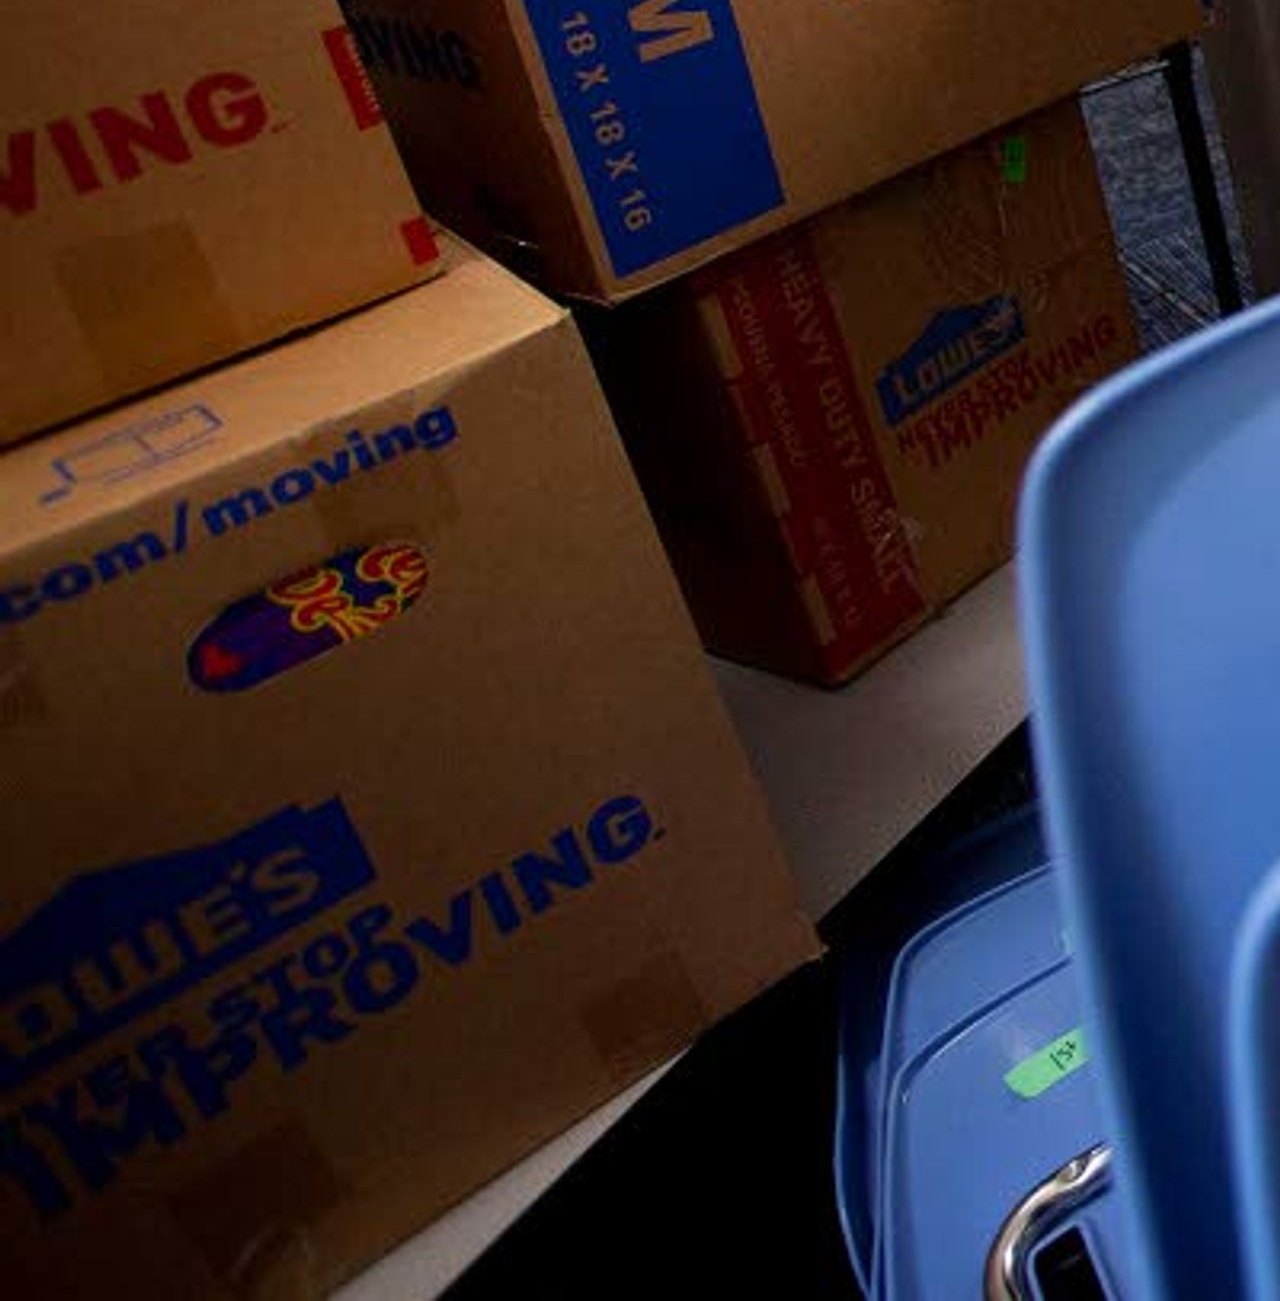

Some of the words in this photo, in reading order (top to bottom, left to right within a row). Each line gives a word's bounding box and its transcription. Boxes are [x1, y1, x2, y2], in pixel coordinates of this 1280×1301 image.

[560, 11, 596, 57] 18
[577, 66, 609, 92] X
[591, 102, 625, 148] 18
[606, 154, 637, 180] X
[621, 189, 652, 233] 16
[208, 905, 394, 1029] STOP
[1049, 1039, 1077, 1071] 1st
